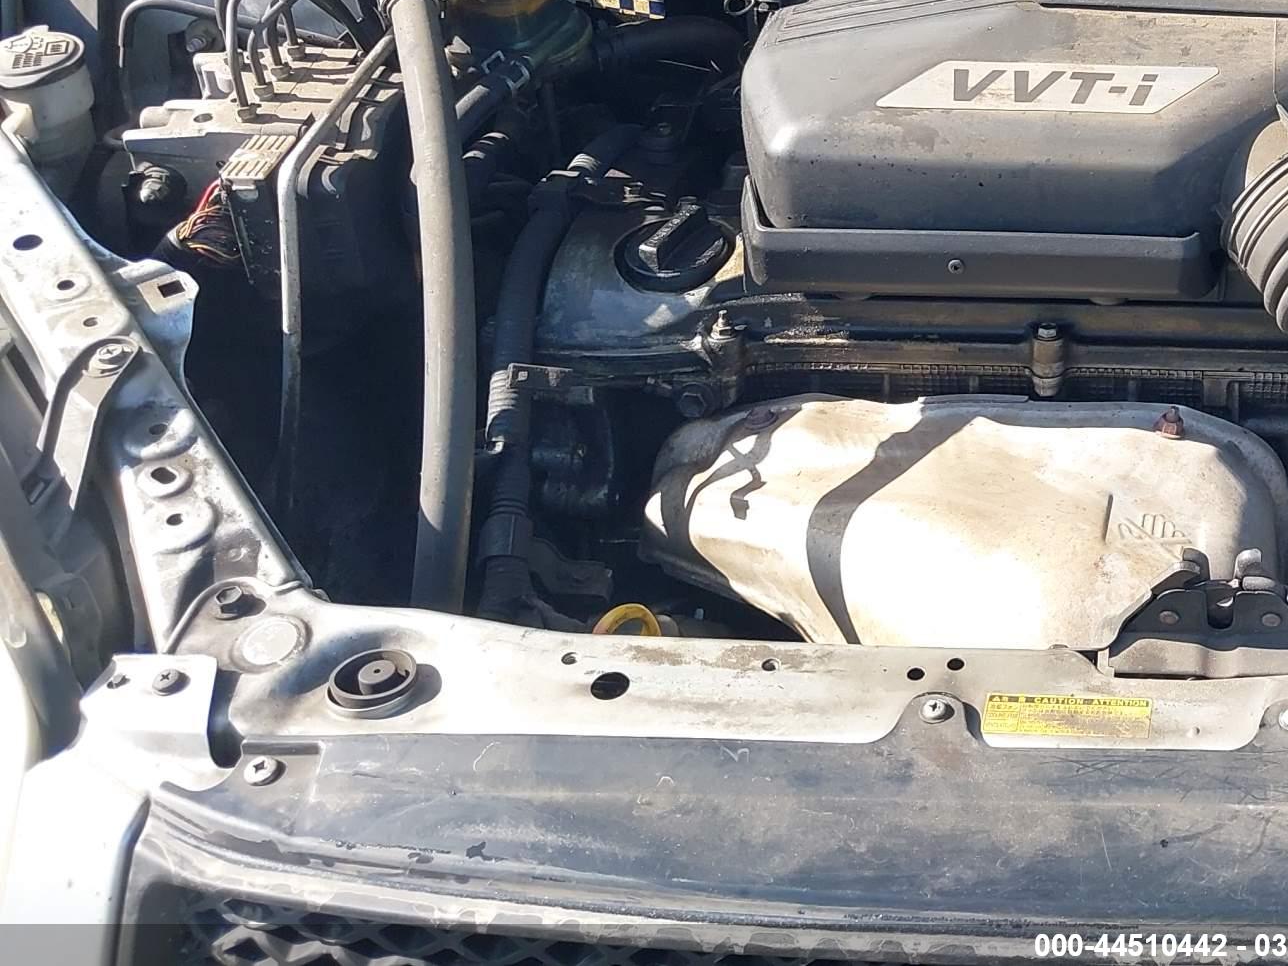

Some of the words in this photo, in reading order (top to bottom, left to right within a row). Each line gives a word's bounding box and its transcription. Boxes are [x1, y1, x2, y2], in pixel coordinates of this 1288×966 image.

[953, 69, 1159, 107] VVT-i
[1034, 696, 1083, 706] CAUTION
[1091, 698, 1148, 708] ATTENTION
